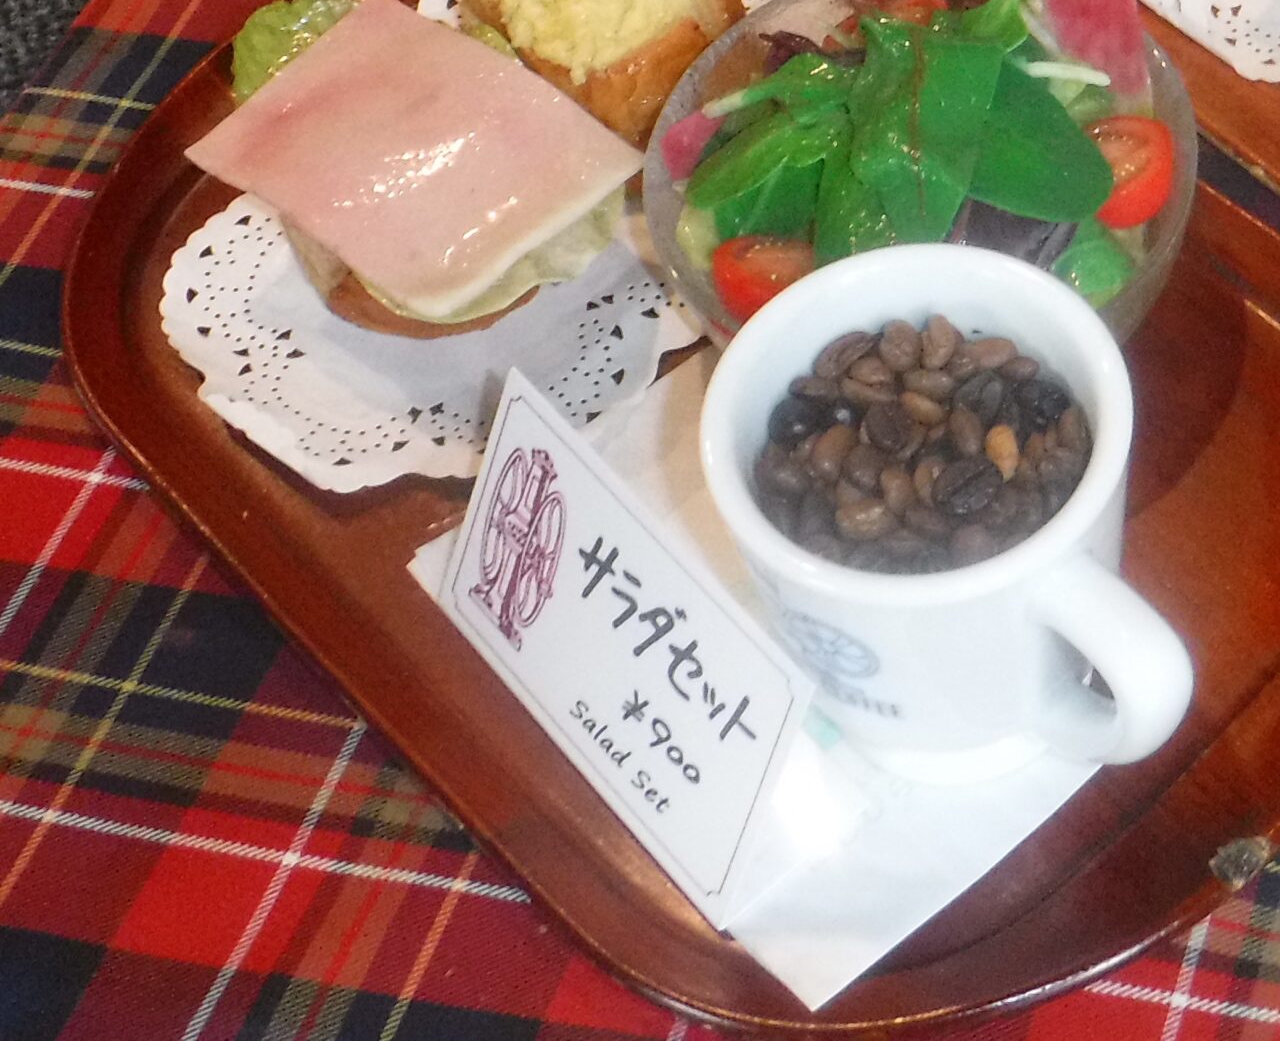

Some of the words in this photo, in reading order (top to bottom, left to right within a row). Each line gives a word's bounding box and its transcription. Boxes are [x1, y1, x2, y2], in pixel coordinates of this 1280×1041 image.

[578, 536, 757, 742] サラダセット
[569, 699, 626, 769] Salad
[631, 771, 672, 815] Set
